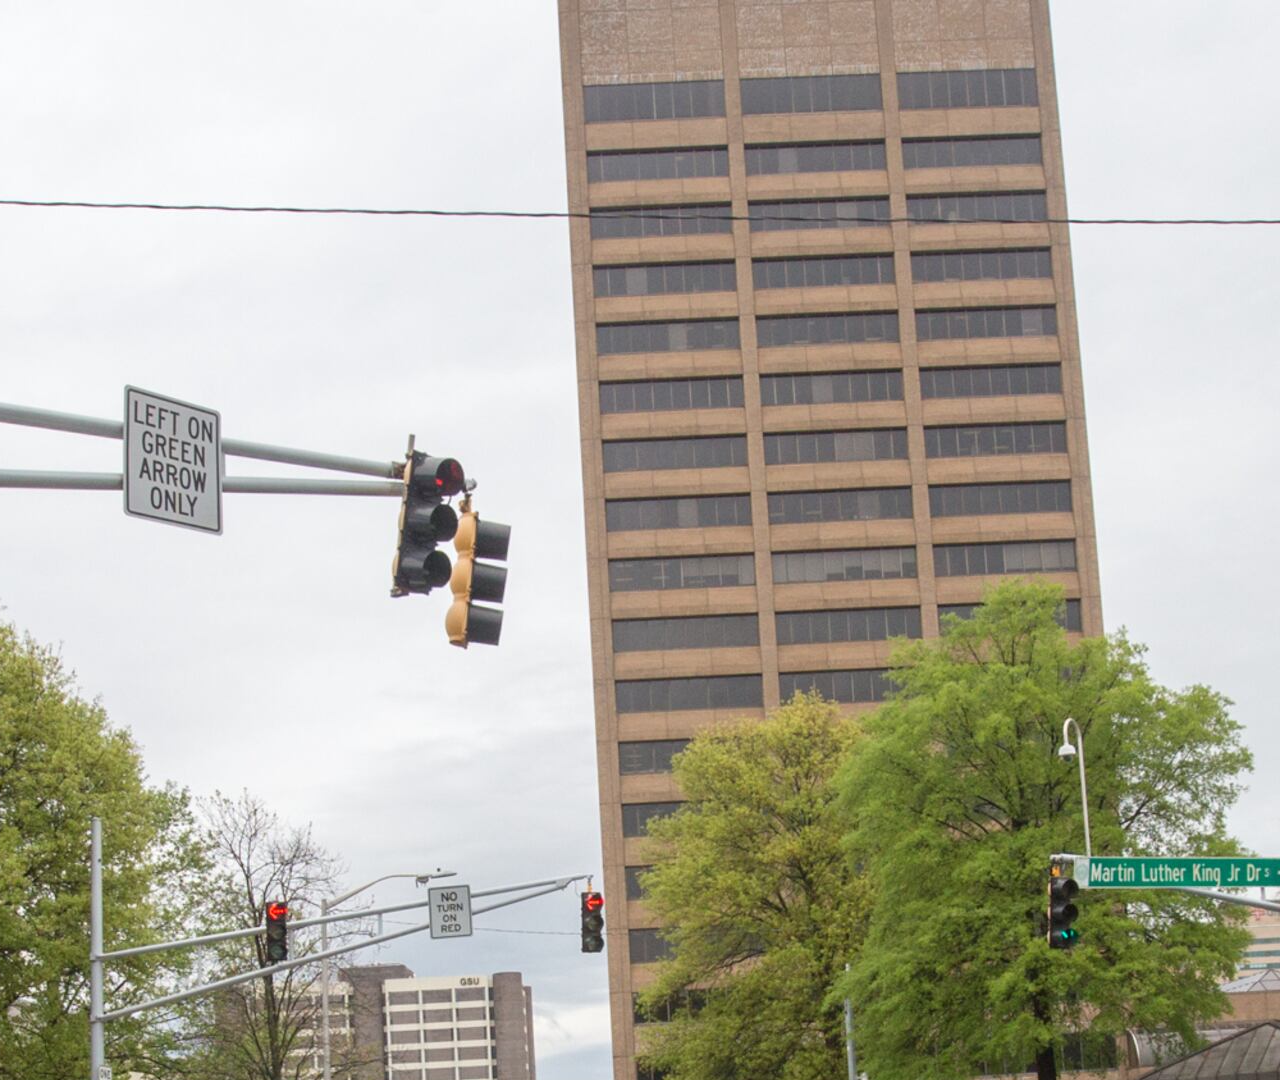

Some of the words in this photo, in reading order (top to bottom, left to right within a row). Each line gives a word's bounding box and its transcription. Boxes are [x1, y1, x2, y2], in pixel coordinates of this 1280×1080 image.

[133, 400, 180, 436] LEFT
[187, 416, 213, 444] ON
[141, 430, 206, 468] GREEN
[139, 457, 207, 494] ARROW
[150, 486, 198, 518] ONLY
[1090, 863, 1135, 882] Martin
[1141, 863, 1186, 882] Luther
[1193, 863, 1220, 887] King
[1227, 863, 1240, 883] Jr
[1247, 863, 1261, 882] Dr
[440, 891, 458, 902] NO
[436, 903, 464, 913] TURN
[442, 914, 457, 923] ON
[440, 923, 462, 933] RED
[460, 976, 480, 986] GSU
[100, 1069, 110, 1080] ONE
